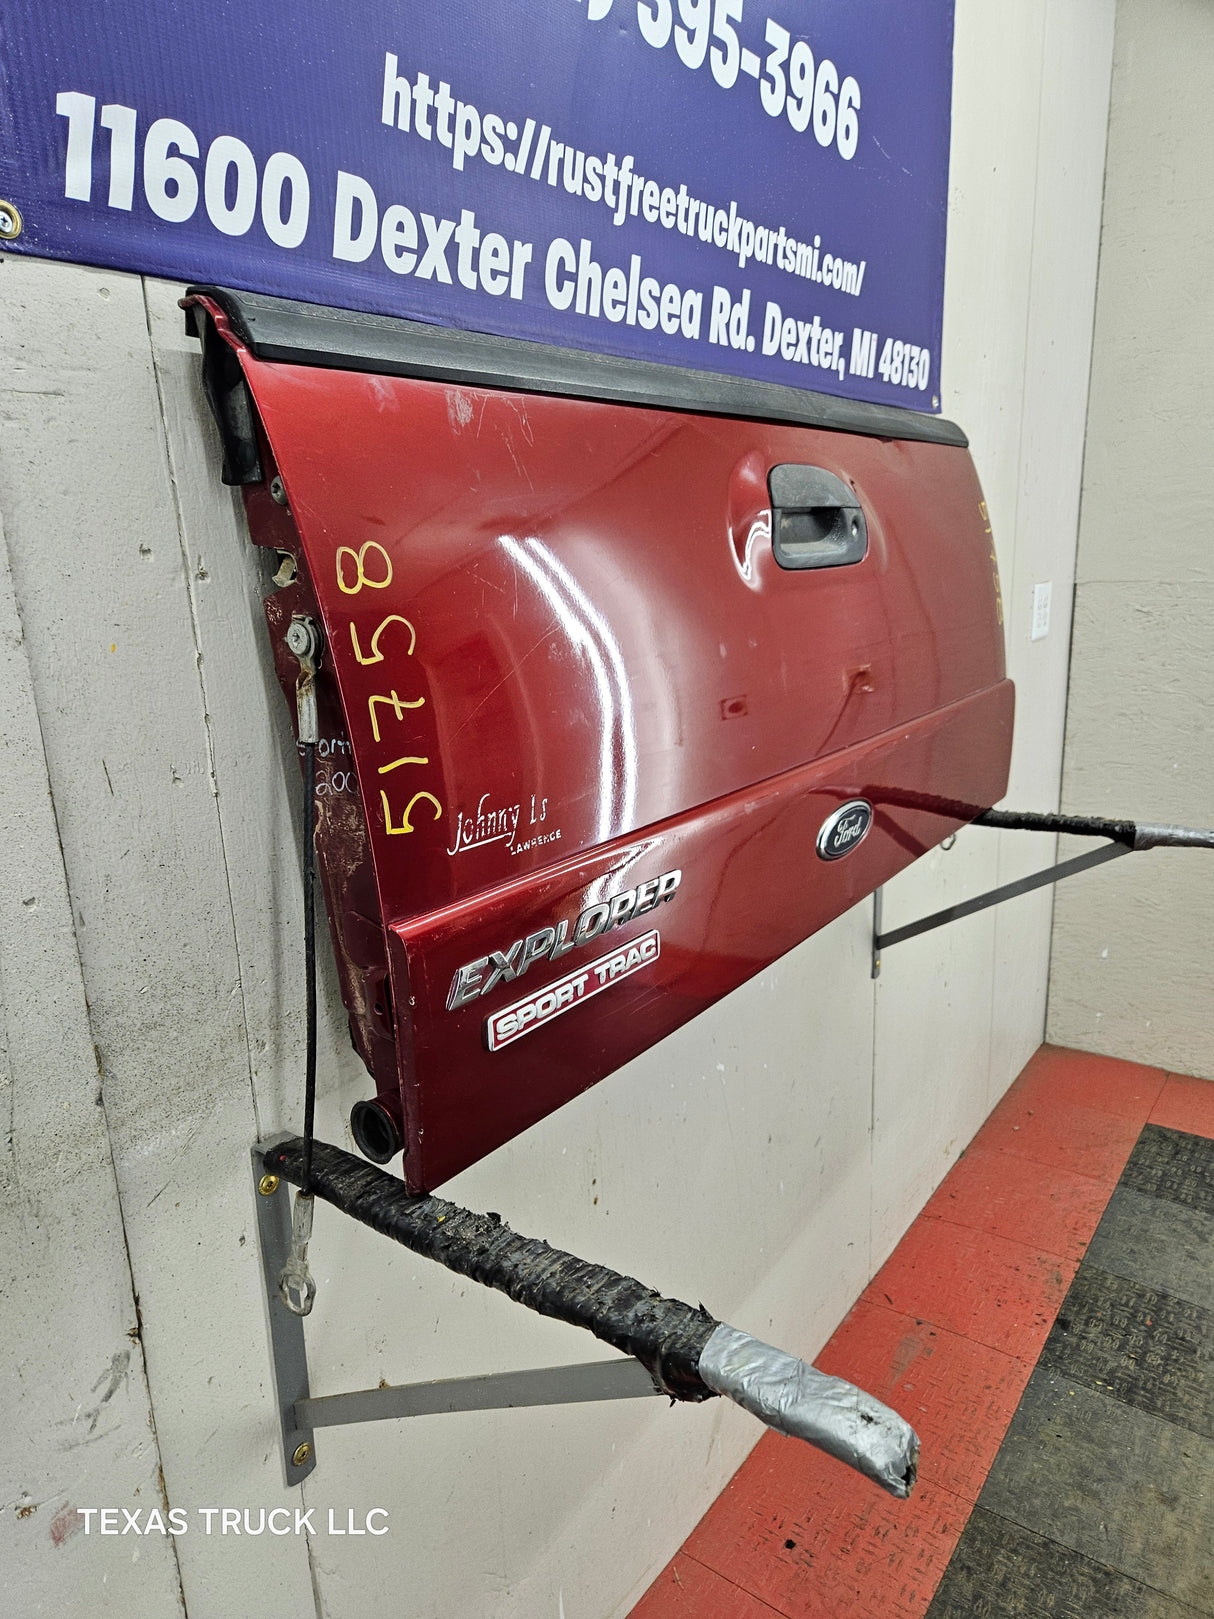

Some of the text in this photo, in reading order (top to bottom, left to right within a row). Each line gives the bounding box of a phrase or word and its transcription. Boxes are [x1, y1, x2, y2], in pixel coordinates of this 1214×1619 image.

[381, 52, 866, 297] https://rustfreetruckpartsmi.com/
[55, 91, 931, 391] 11600 Dexter Chelsea Rd. Dexter, MI 48130
[336, 540, 443, 836] 51758
[446, 793, 521, 856] Johnny
[510, 828, 562, 856] LAWRENCE
[833, 813, 863, 848] Ford
[445, 869, 683, 1012] EXPLORER
[495, 942, 659, 1043] SPORT TRAC
